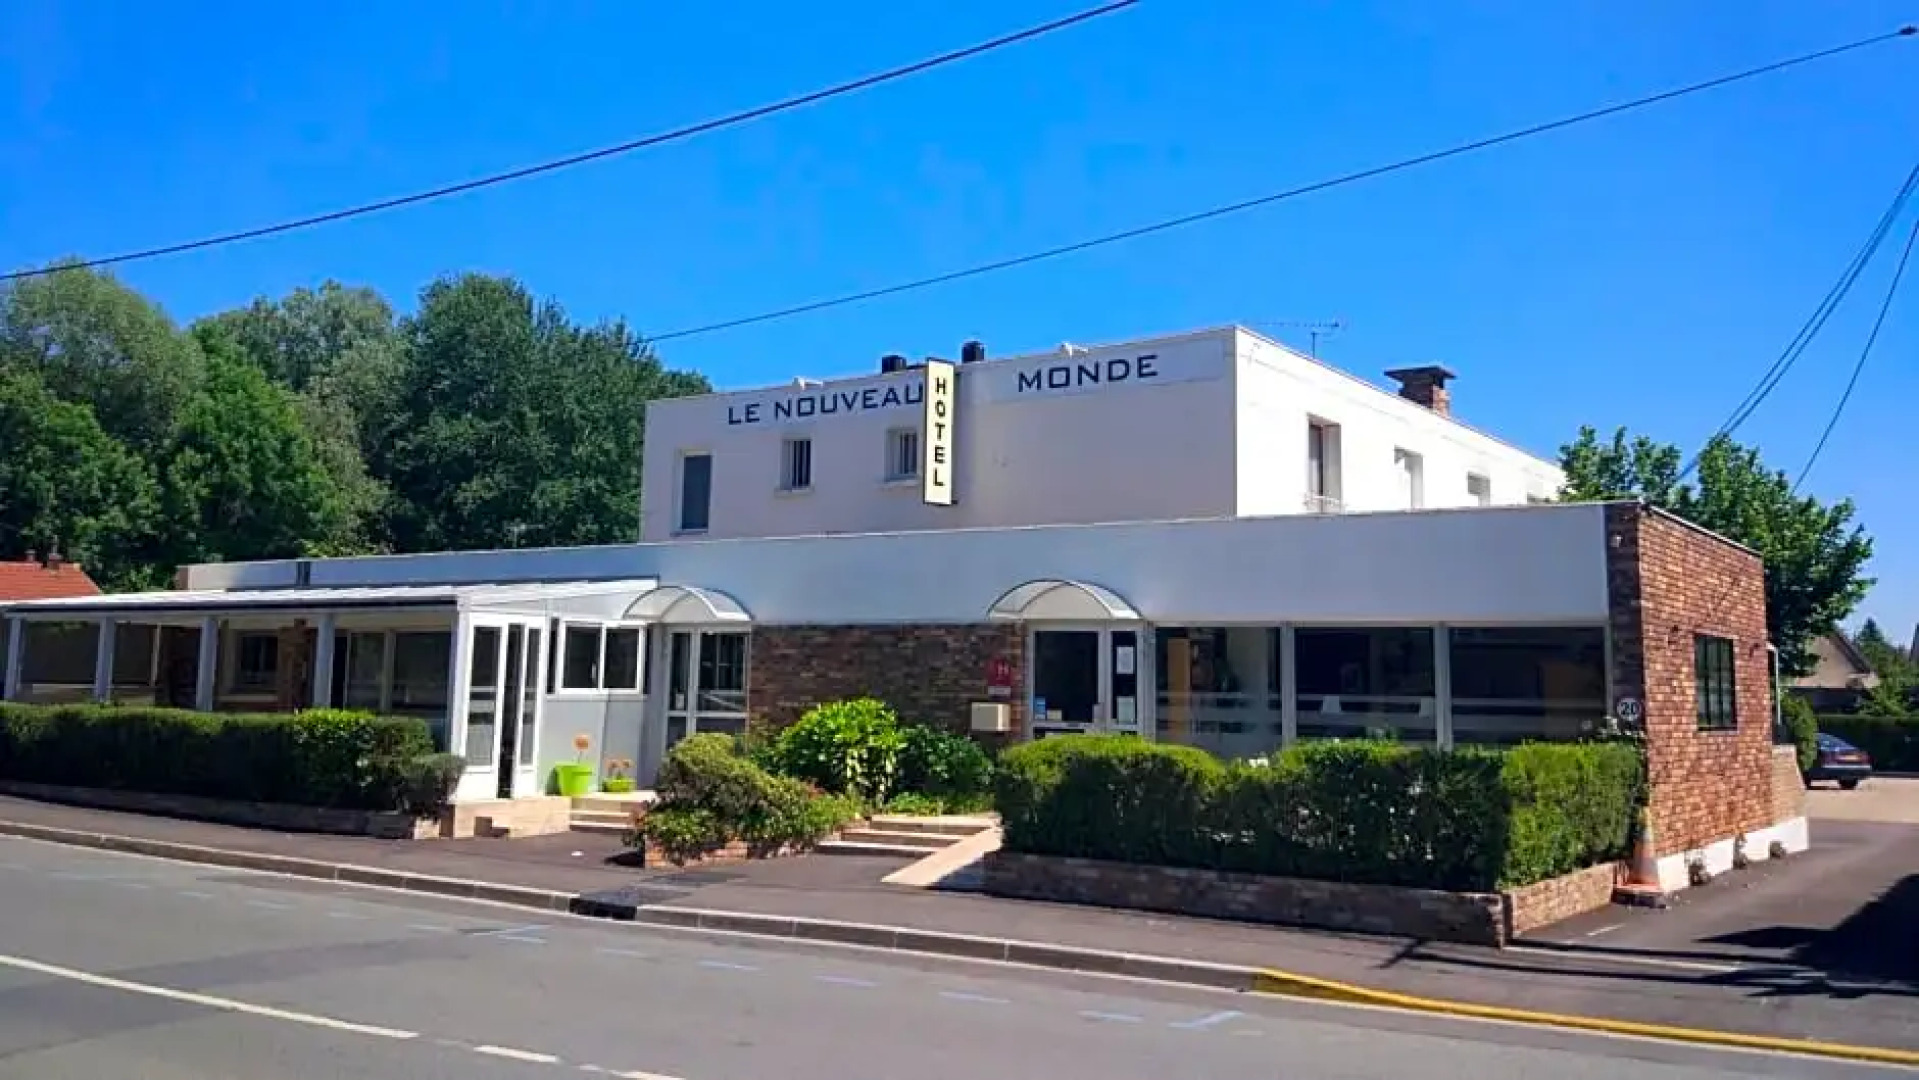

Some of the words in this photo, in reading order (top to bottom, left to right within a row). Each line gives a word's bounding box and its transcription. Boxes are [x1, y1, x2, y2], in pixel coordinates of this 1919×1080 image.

[728, 403, 761, 425] LE
[774, 385, 924, 418] NOUVEAU
[1018, 354, 1159, 393] MONDE
[933, 376, 946, 487] HOTEL
[1620, 701, 1638, 716] 20
